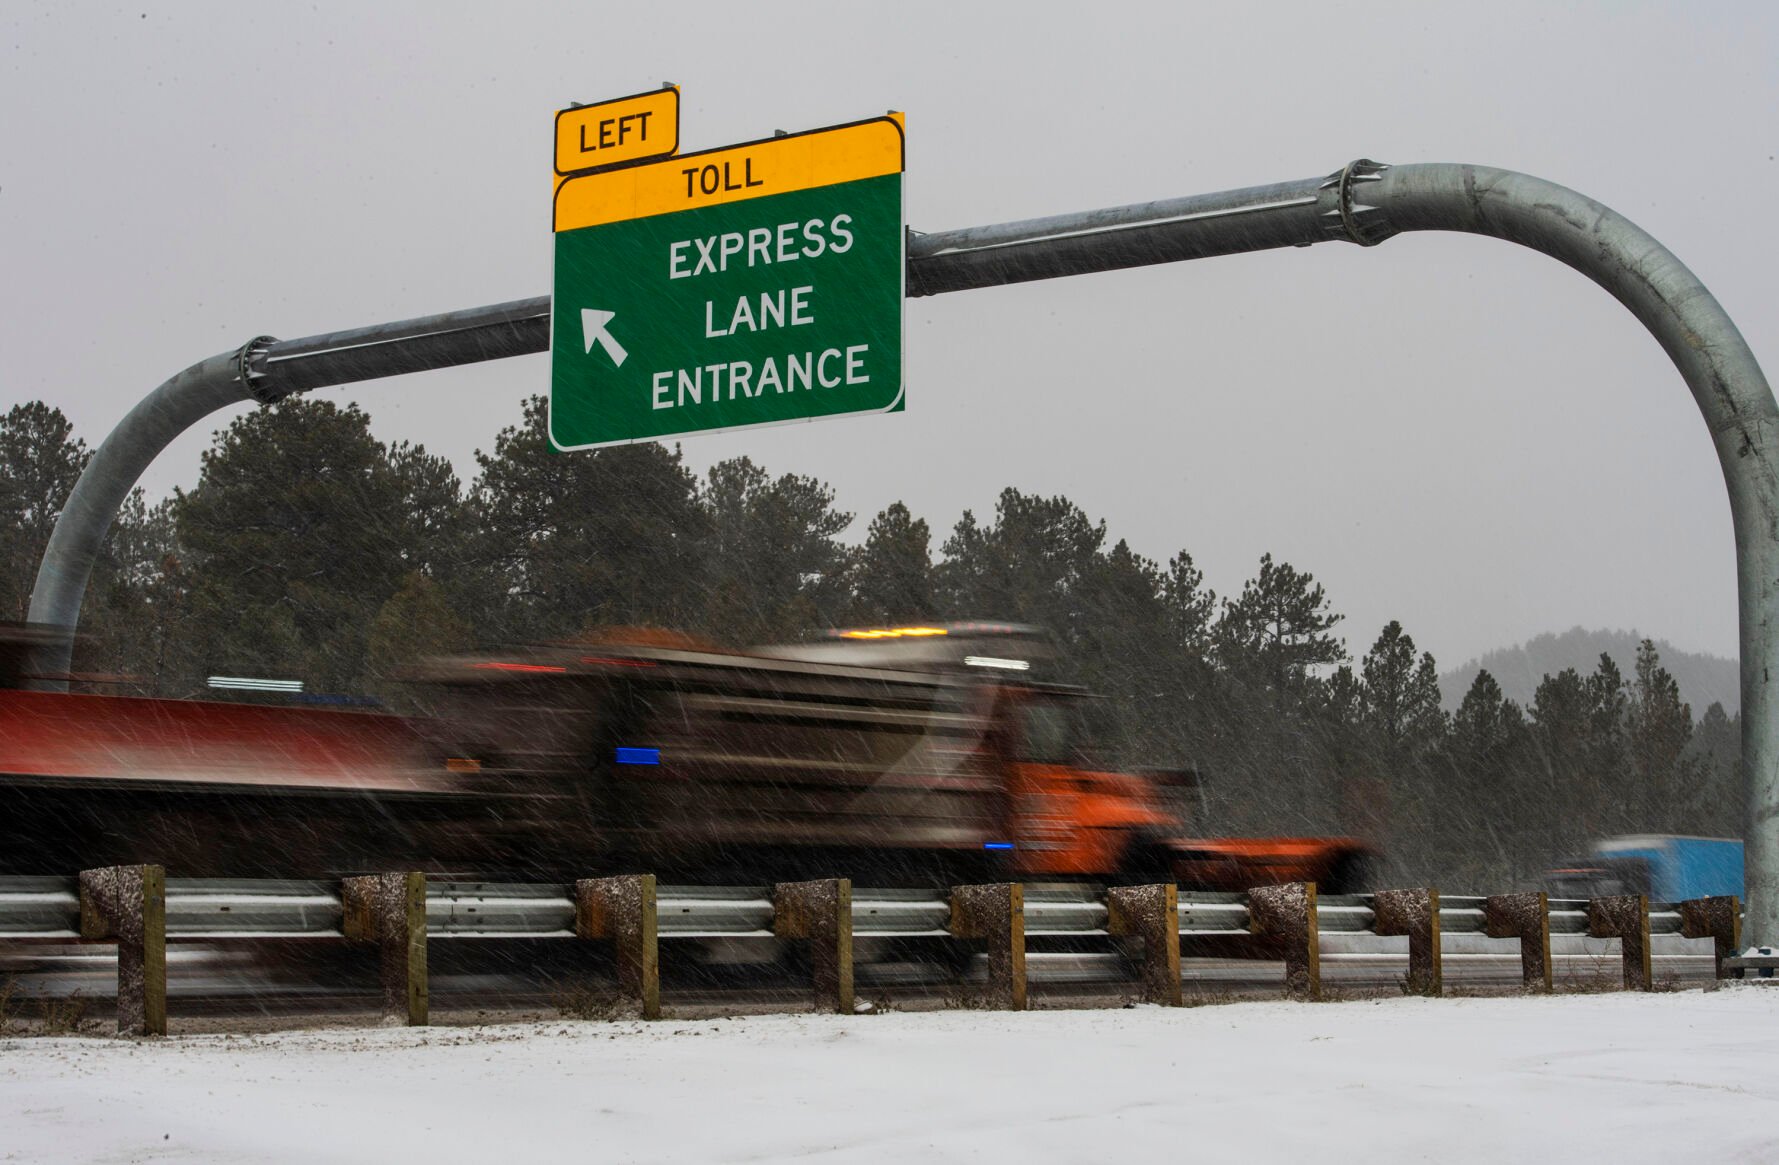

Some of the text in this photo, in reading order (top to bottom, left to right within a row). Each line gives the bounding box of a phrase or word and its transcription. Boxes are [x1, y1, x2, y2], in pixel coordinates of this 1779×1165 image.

[580, 111, 652, 153] LEFT
[682, 158, 763, 198] TOLL
[669, 214, 853, 280] EXPRESS
[706, 285, 814, 338] LANE
[652, 344, 870, 410] ENTRANCE
